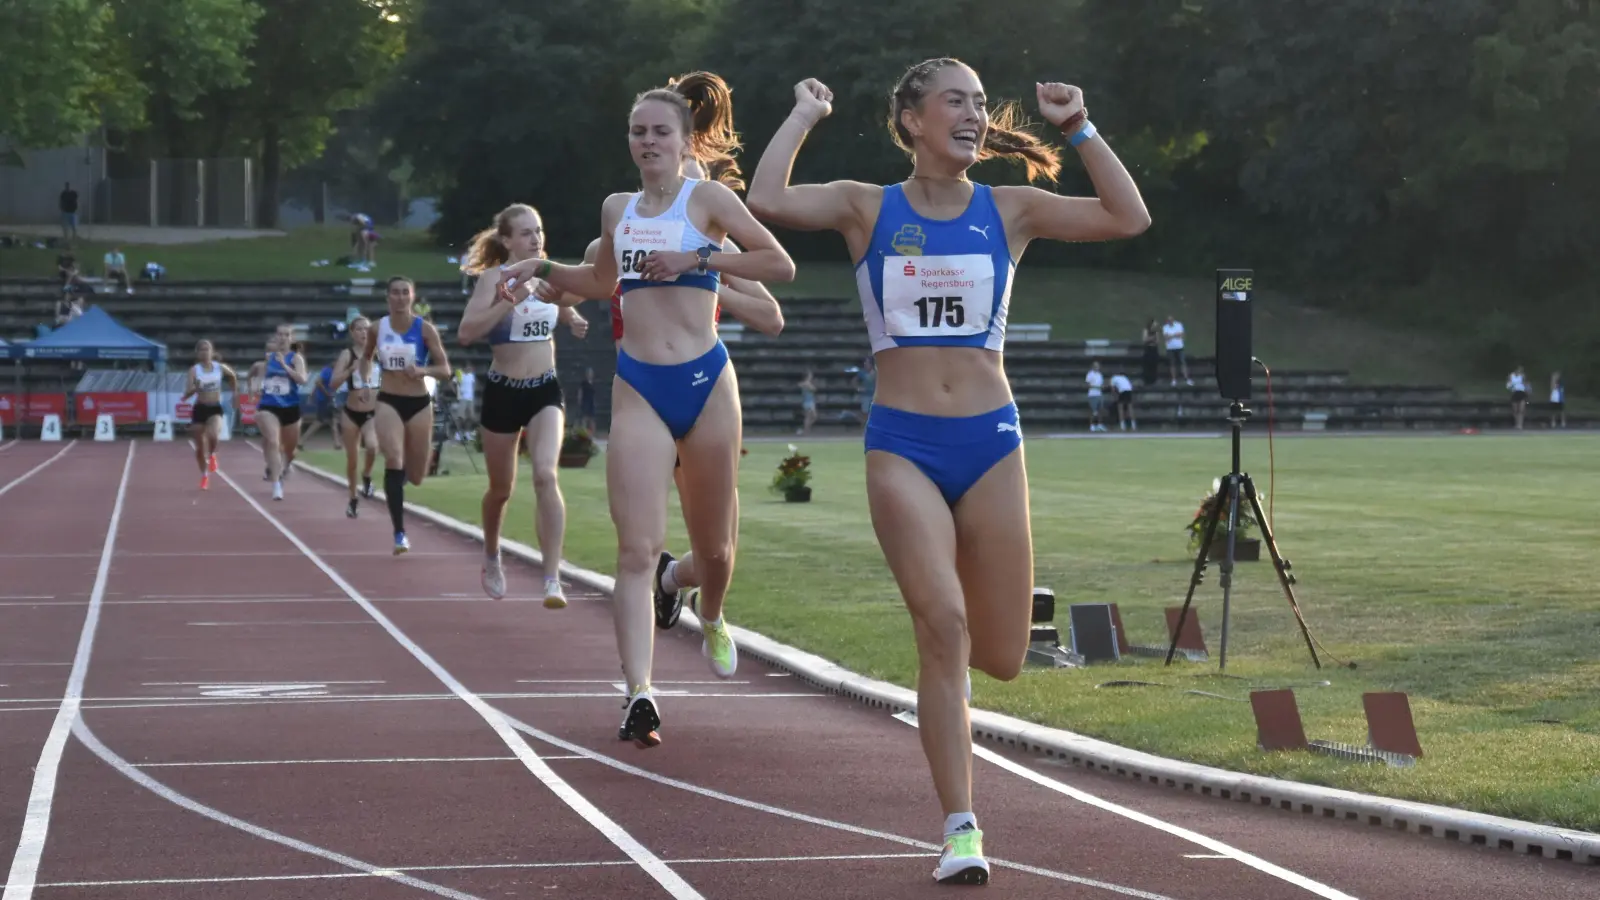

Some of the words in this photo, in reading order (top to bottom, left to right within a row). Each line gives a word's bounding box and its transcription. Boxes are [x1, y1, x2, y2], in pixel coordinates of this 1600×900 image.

[632, 228, 662, 236] Sparkasse
[632, 237, 667, 245] Regensburg
[622, 249, 658, 273] 50
[920, 268, 965, 277] Sparkasse
[921, 280, 975, 289] Regensburg
[1220, 278, 1252, 290] ALGE
[914, 297, 965, 328] 175
[523, 321, 549, 337] 536
[389, 356, 405, 367] 116
[504, 377, 541, 389] NIKE
[46, 421, 55, 433] 4
[101, 421, 109, 433] 3
[159, 420, 167, 433] 2
